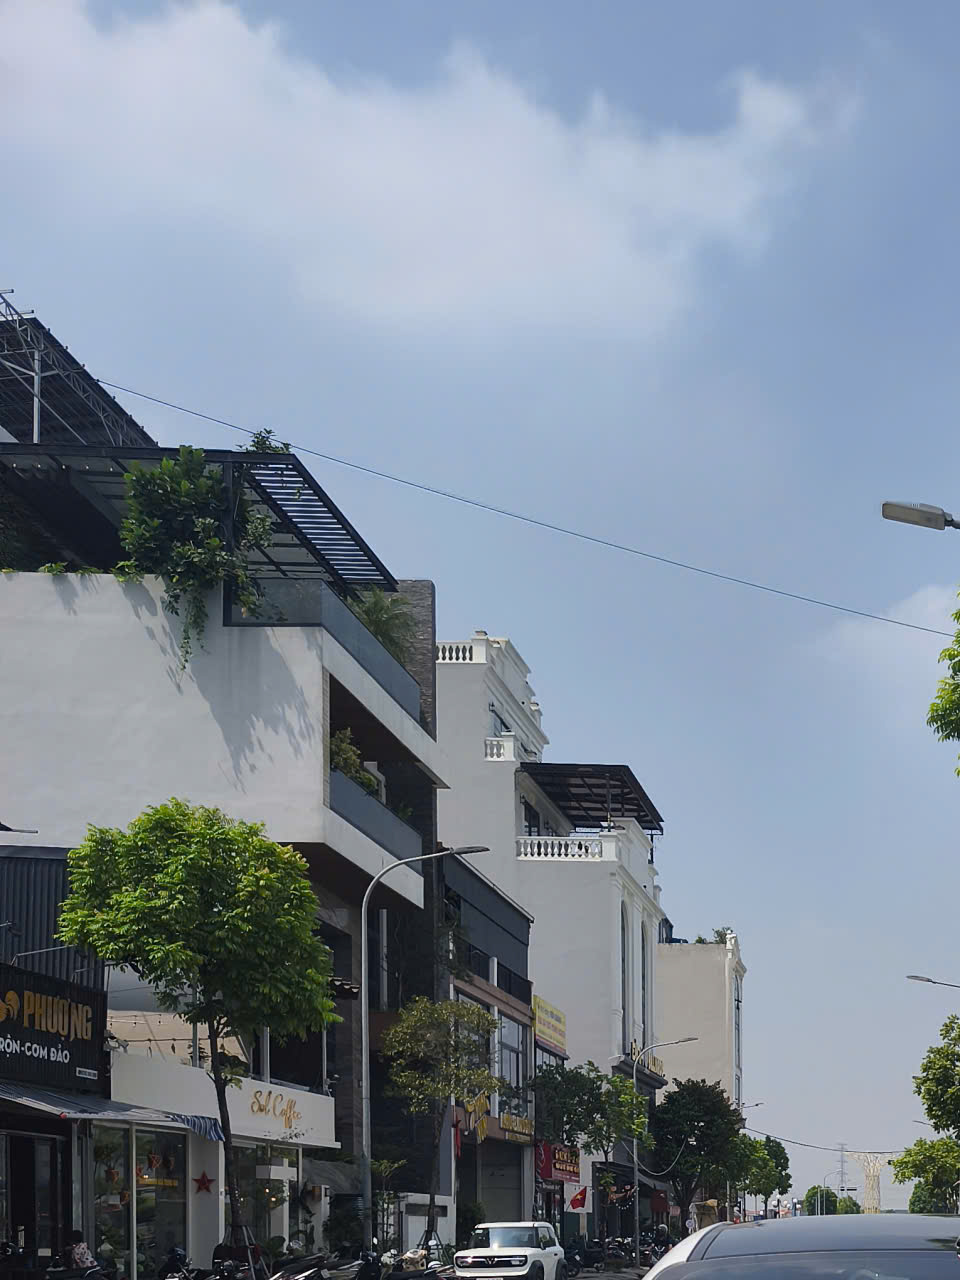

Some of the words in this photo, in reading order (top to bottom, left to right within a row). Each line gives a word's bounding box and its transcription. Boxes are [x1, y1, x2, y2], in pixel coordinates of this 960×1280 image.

[23, 990, 92, 1041] PHƯỢNG
[49, 1044, 70, 1064] ĐẢO
[272, 1093, 302, 1129] Coffee
